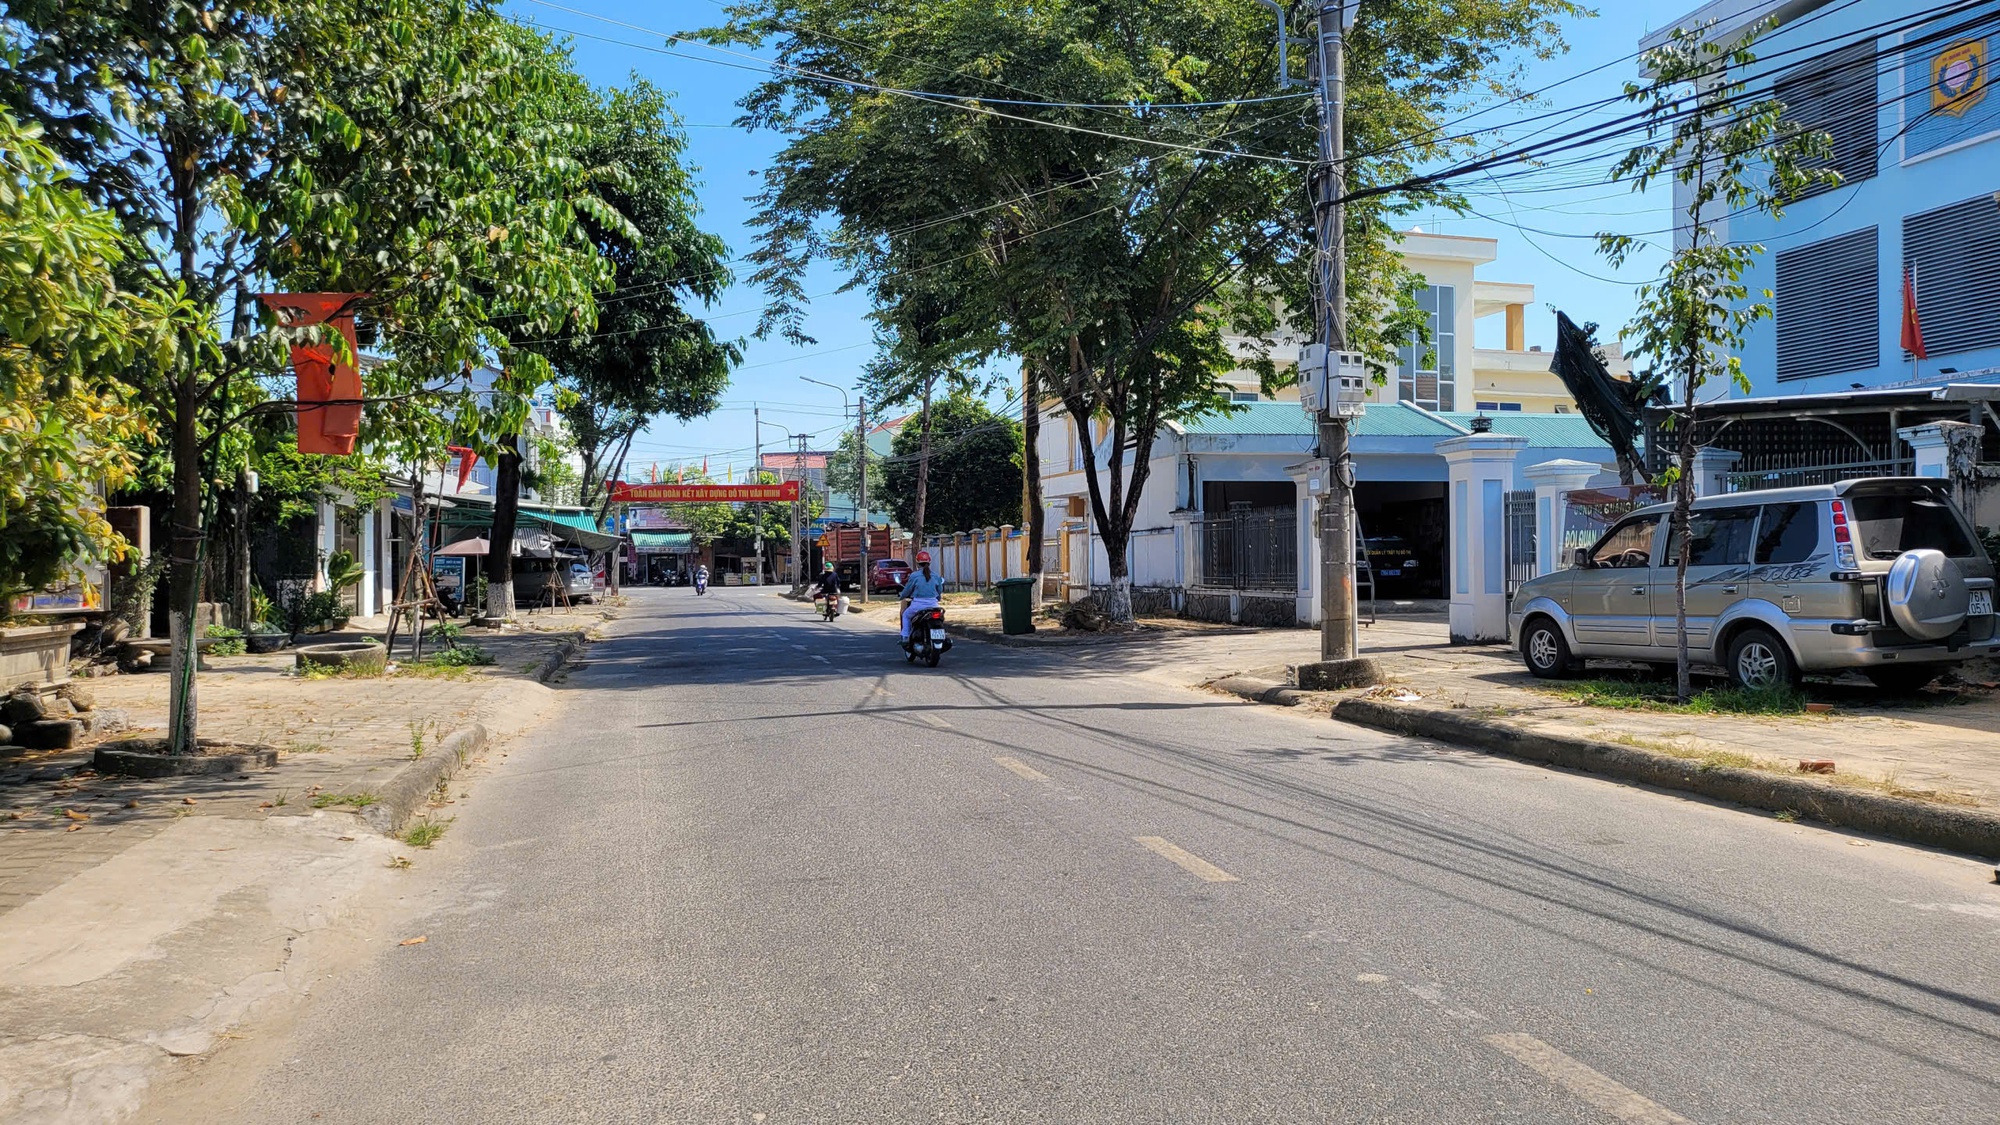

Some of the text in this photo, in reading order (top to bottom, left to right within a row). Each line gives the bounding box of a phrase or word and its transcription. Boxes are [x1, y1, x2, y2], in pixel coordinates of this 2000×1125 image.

[630, 489, 647, 498] TOÀN
[648, 488, 661, 498] DÂN
[662, 488, 680, 498] ĐOÀN
[682, 487, 695, 498] KẾT
[696, 488, 708, 498] XÂY
[709, 489, 727, 499] DỰNG
[738, 489, 749, 499] THỊ
[749, 488, 762, 498] VĂN
[763, 489, 780, 498] MINH
